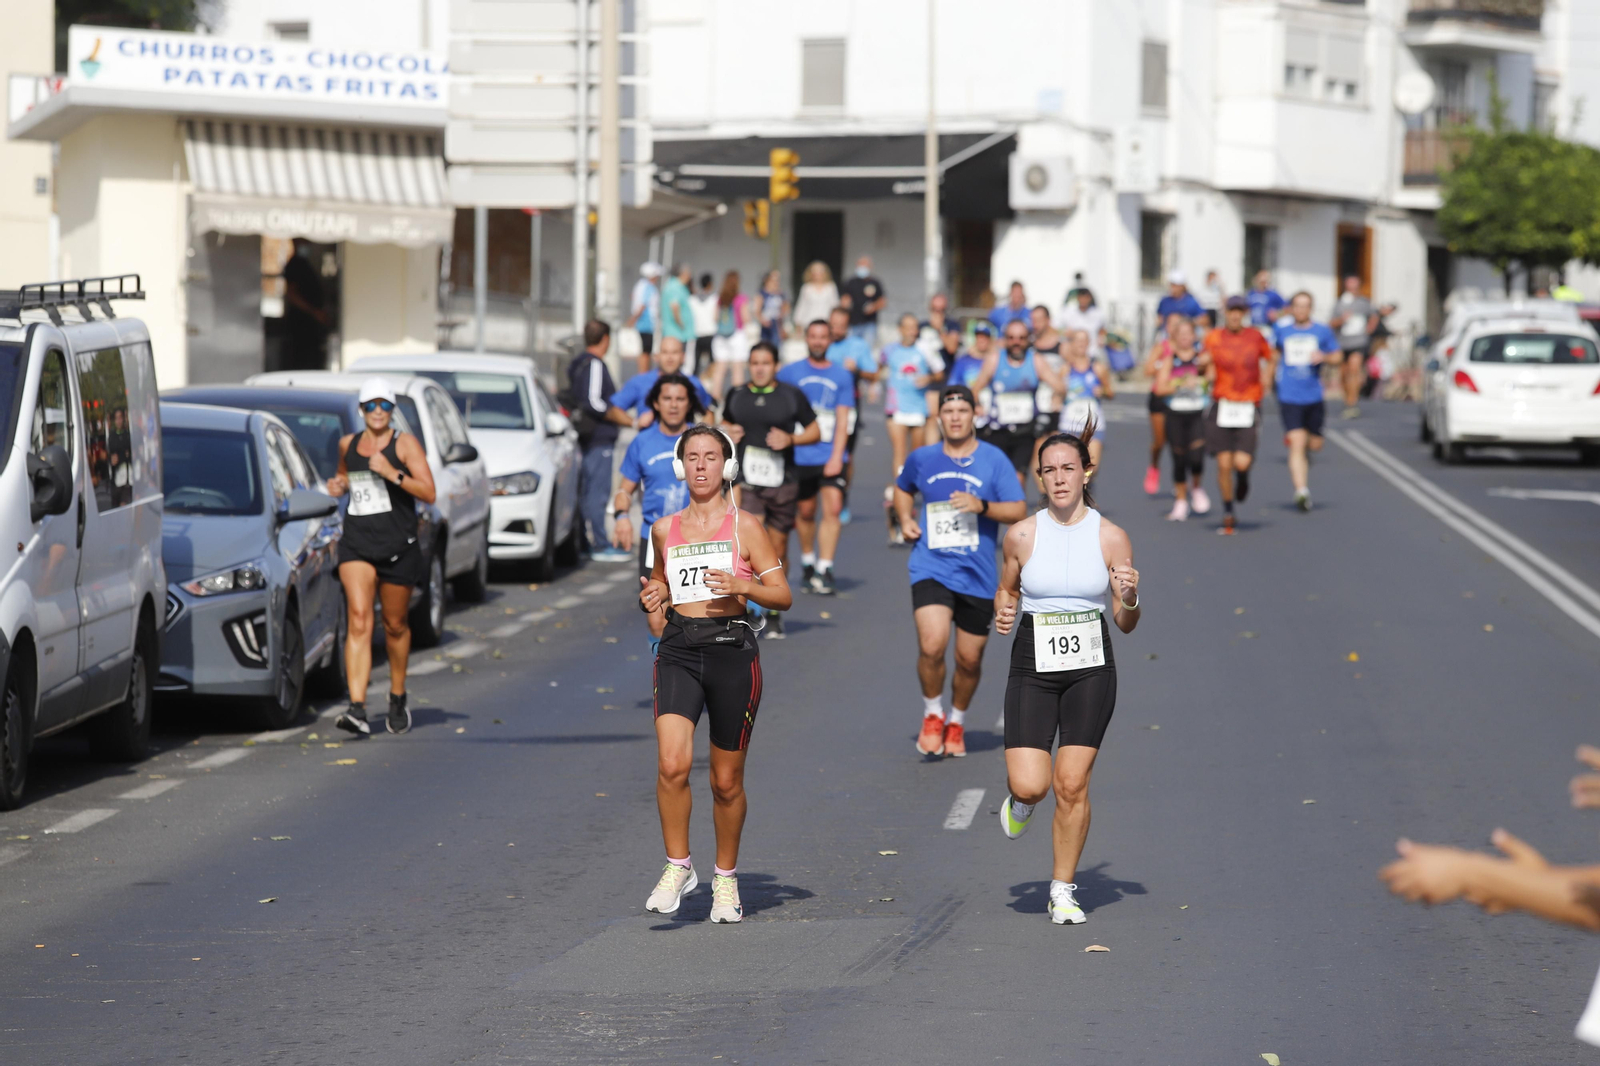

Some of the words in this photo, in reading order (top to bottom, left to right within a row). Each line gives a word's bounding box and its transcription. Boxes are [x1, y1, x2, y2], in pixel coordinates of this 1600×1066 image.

[118, 39, 275, 65] CHURROS
[164, 67, 312, 92] PATATAS
[326, 77, 439, 100] FRITAS
[678, 546, 699, 556] VUELTA
[700, 546, 705, 554] A
[706, 544, 728, 553] HUELVA
[1038, 616, 1046, 625] 34
[1047, 615, 1069, 624] VUELTA
[1070, 615, 1075, 623] A
[1076, 612, 1097, 623] HUELVA
[1048, 635, 1081, 655] 193
